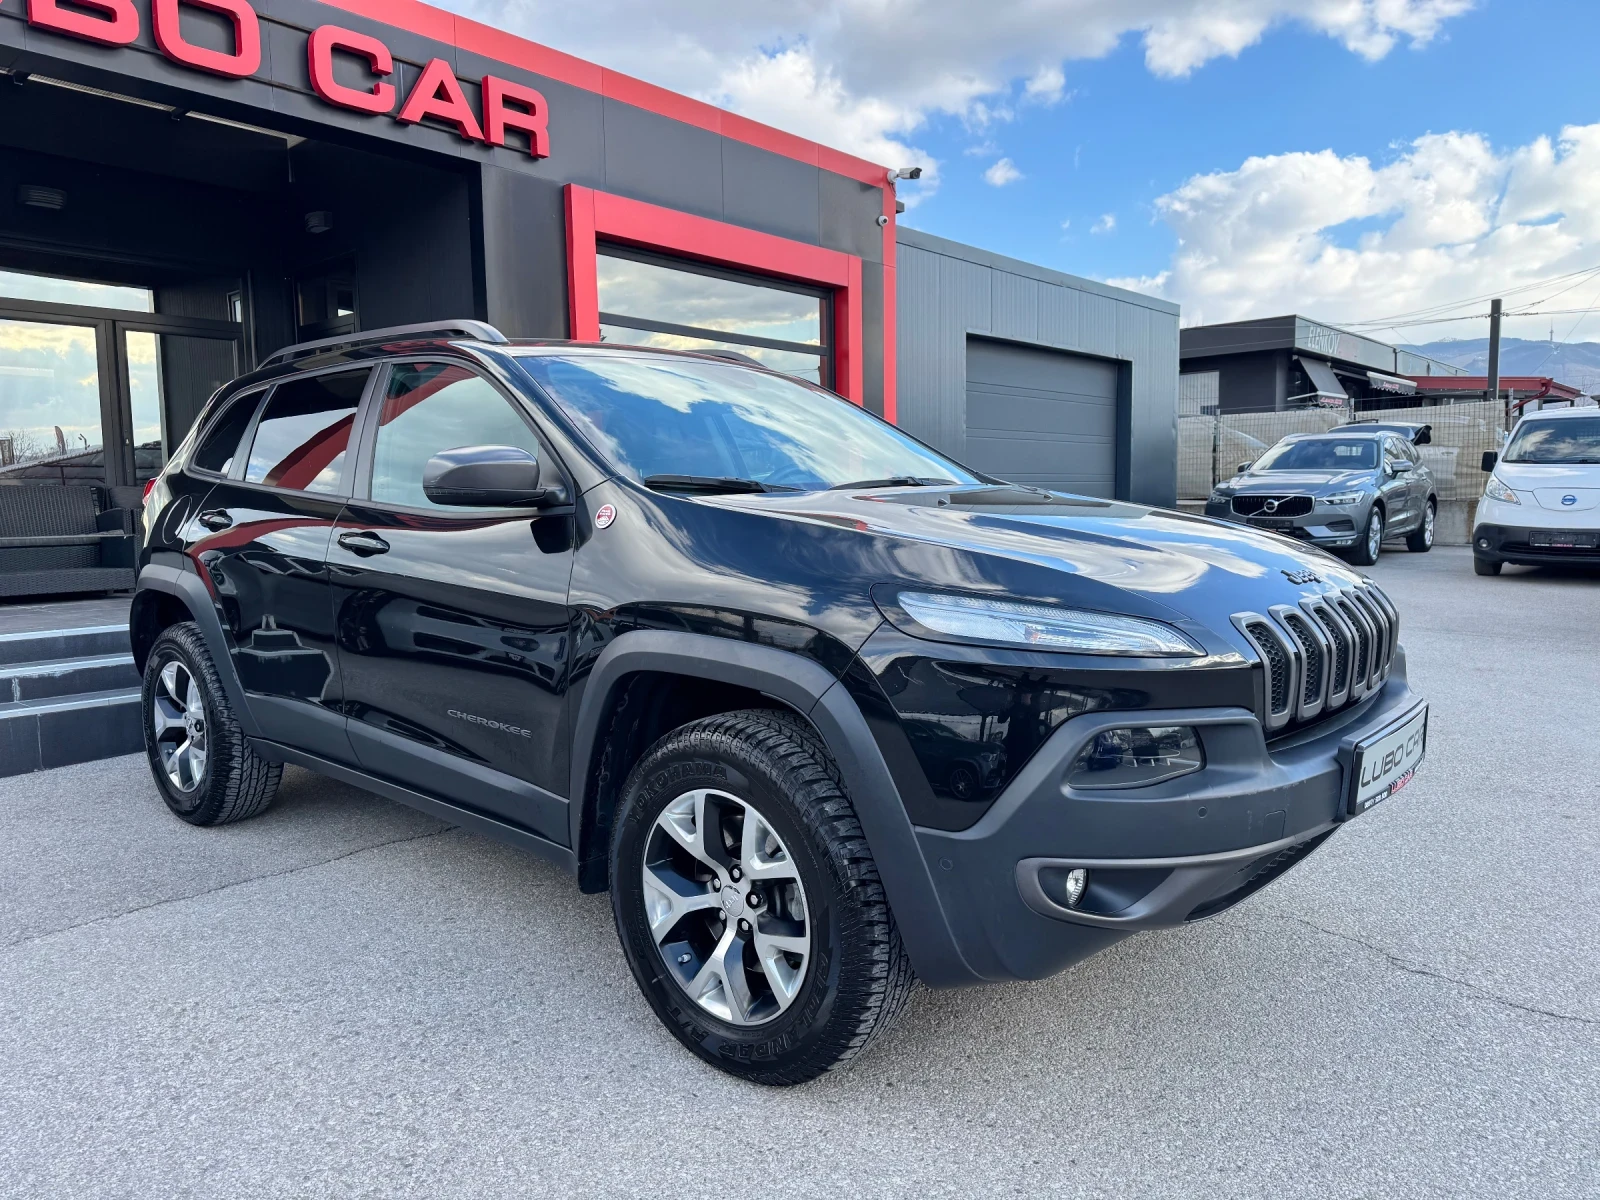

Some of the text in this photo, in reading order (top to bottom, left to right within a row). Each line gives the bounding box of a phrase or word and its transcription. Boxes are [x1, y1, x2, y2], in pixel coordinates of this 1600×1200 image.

[308, 24, 549, 159] CAR
[1307, 326, 1341, 355] ELENKOV
[446, 709, 532, 738] CHEROKEE
[1360, 743, 1404, 788] LUBO
[629, 761, 728, 823] YOKOHAMA
[666, 1005, 711, 1043] A/T
